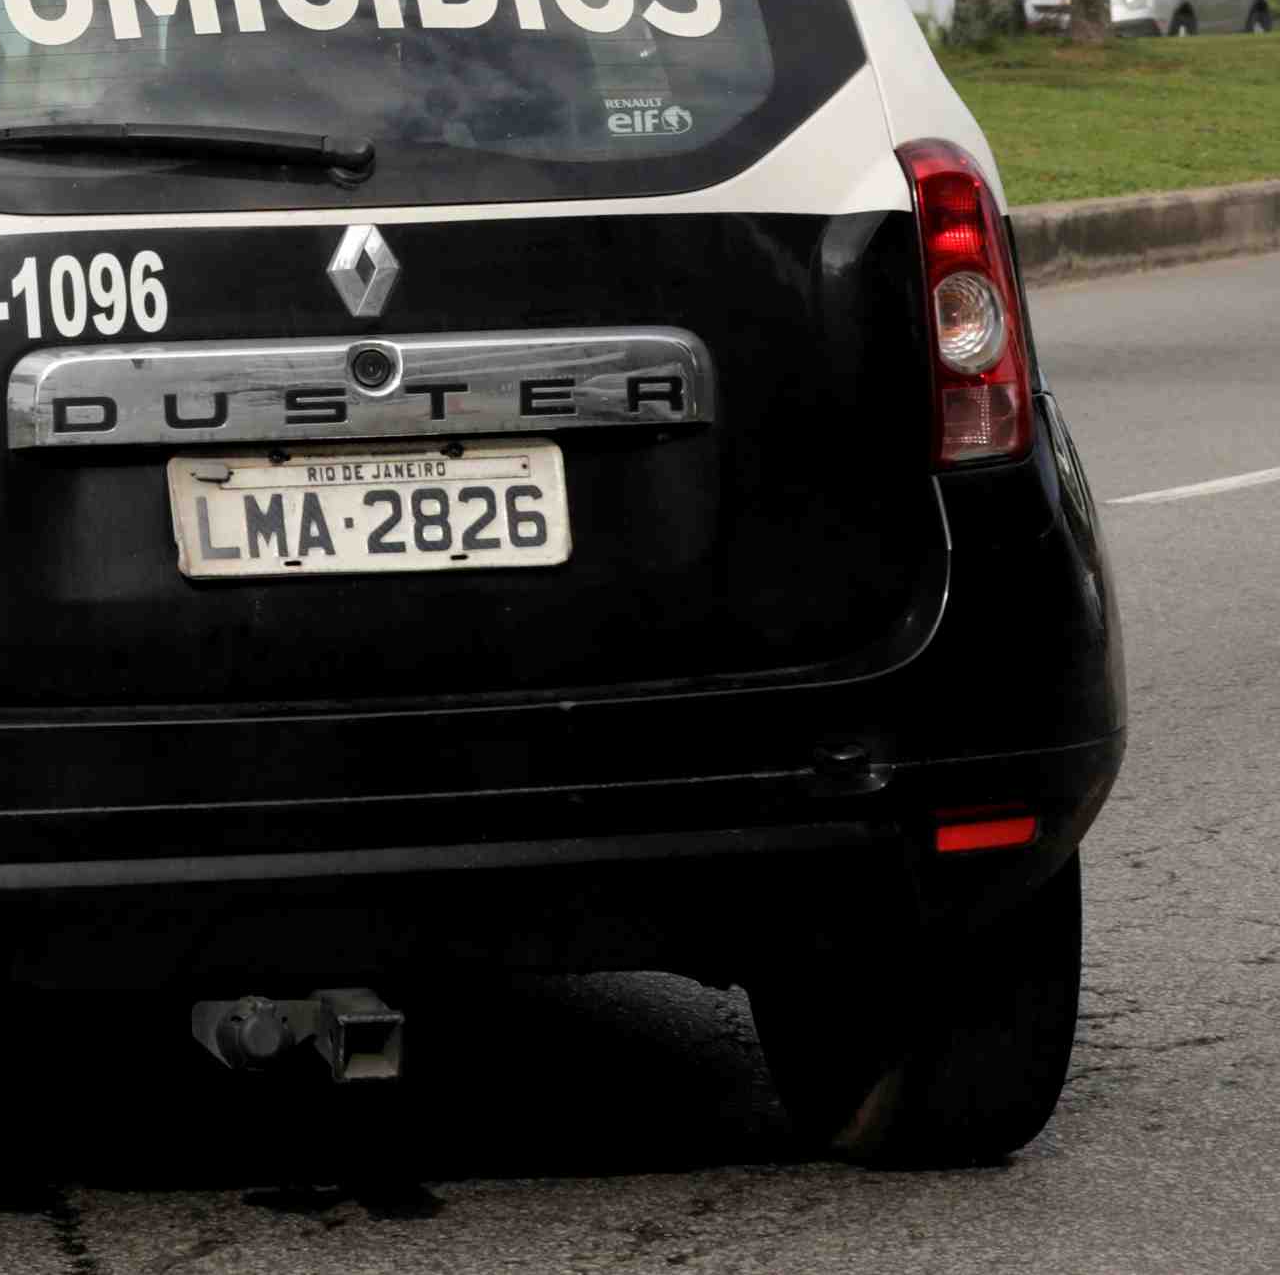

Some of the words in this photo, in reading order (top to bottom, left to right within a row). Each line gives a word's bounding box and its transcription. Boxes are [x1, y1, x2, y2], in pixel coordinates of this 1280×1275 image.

[604, 98, 663, 109] RENAULT
[607, 110, 659, 133] elf
[51, 376, 685, 434] DUSTER
[307, 464, 334, 483] RIO
[342, 463, 364, 481] DE
[371, 461, 447, 480] JANEIRO
